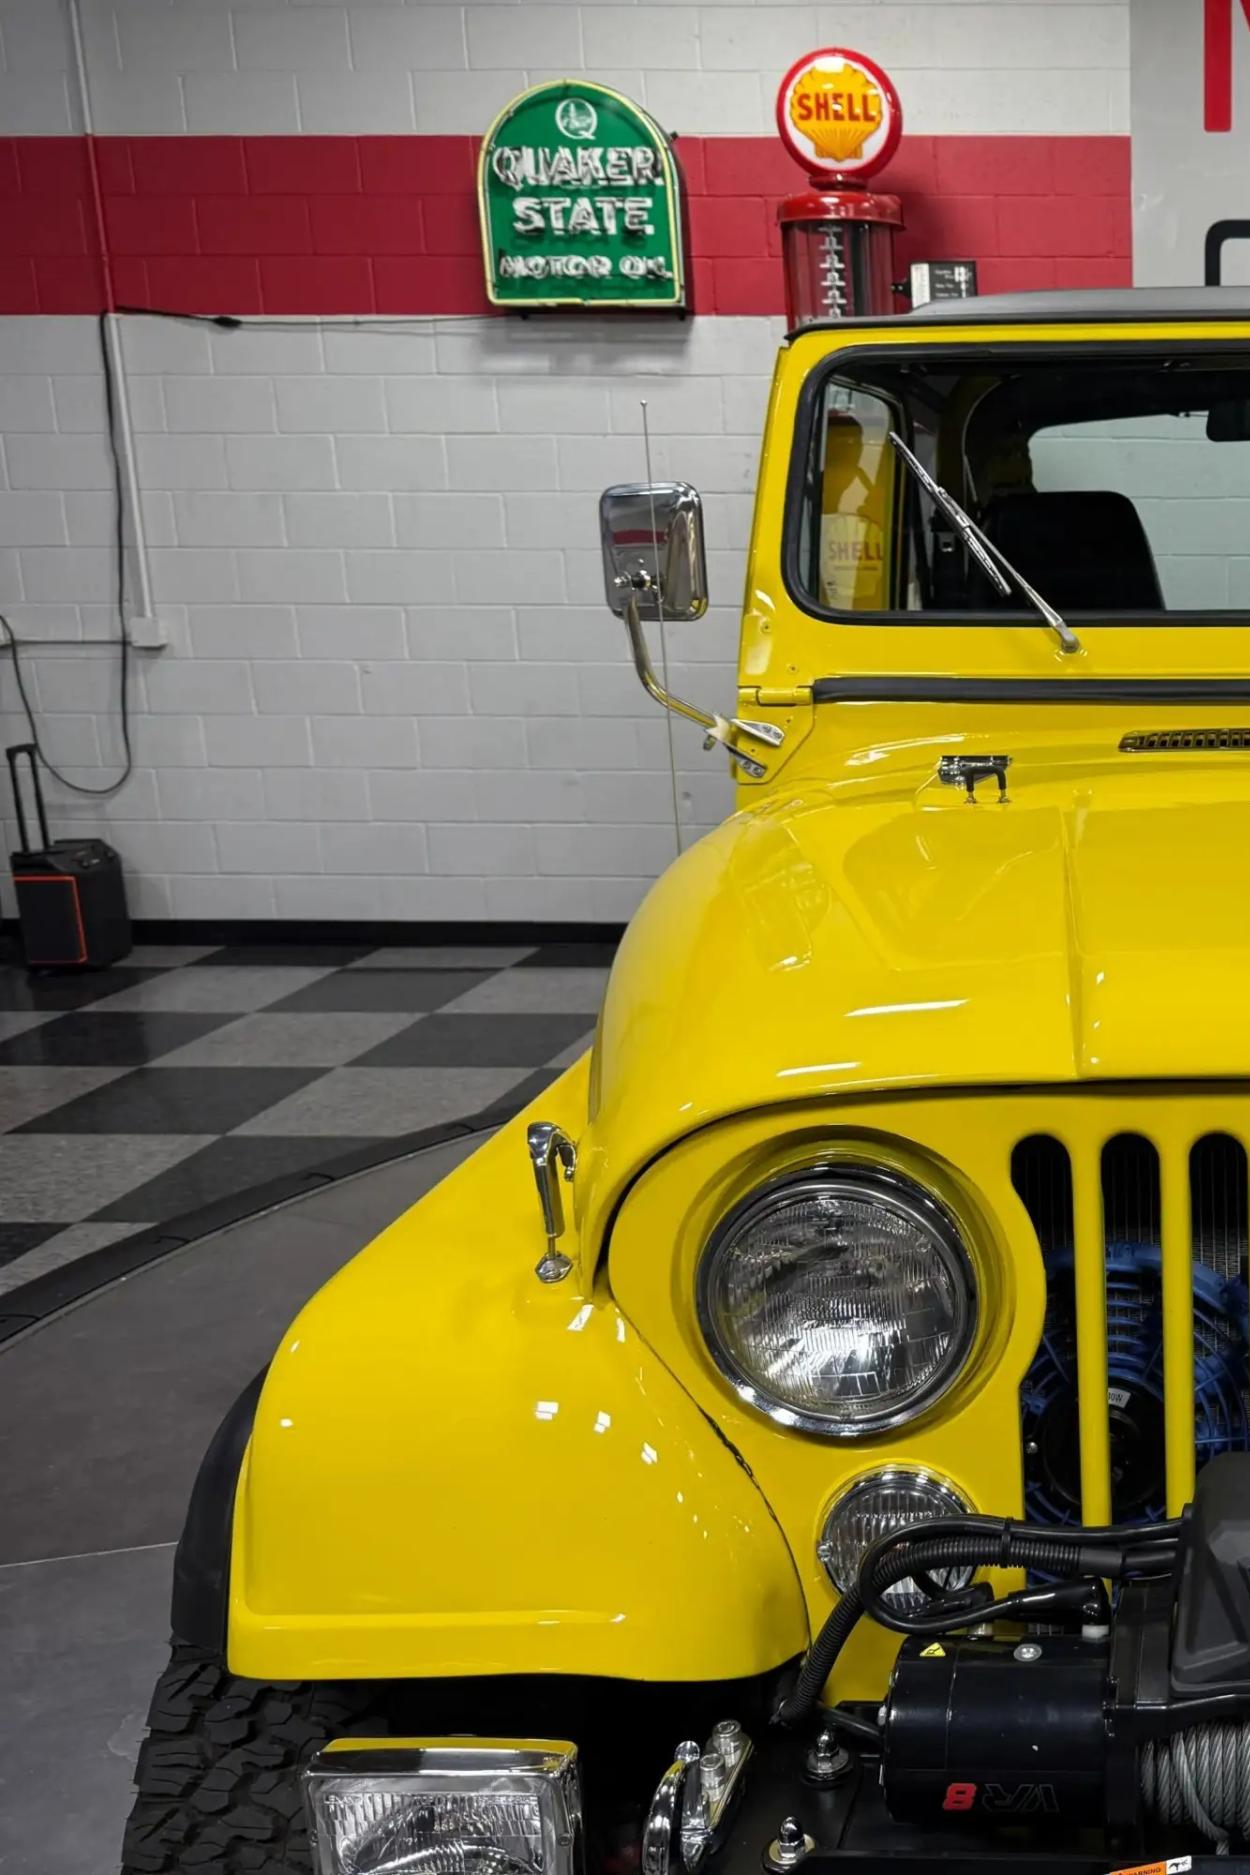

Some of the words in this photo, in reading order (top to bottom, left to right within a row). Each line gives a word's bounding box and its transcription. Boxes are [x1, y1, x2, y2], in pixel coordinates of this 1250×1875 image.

[797, 93, 877, 124] SHELL
[492, 145, 665, 191] QUAKER
[512, 197, 655, 235] STATE
[500, 255, 613, 279] MOTOR
[619, 255, 673, 279] OIL
